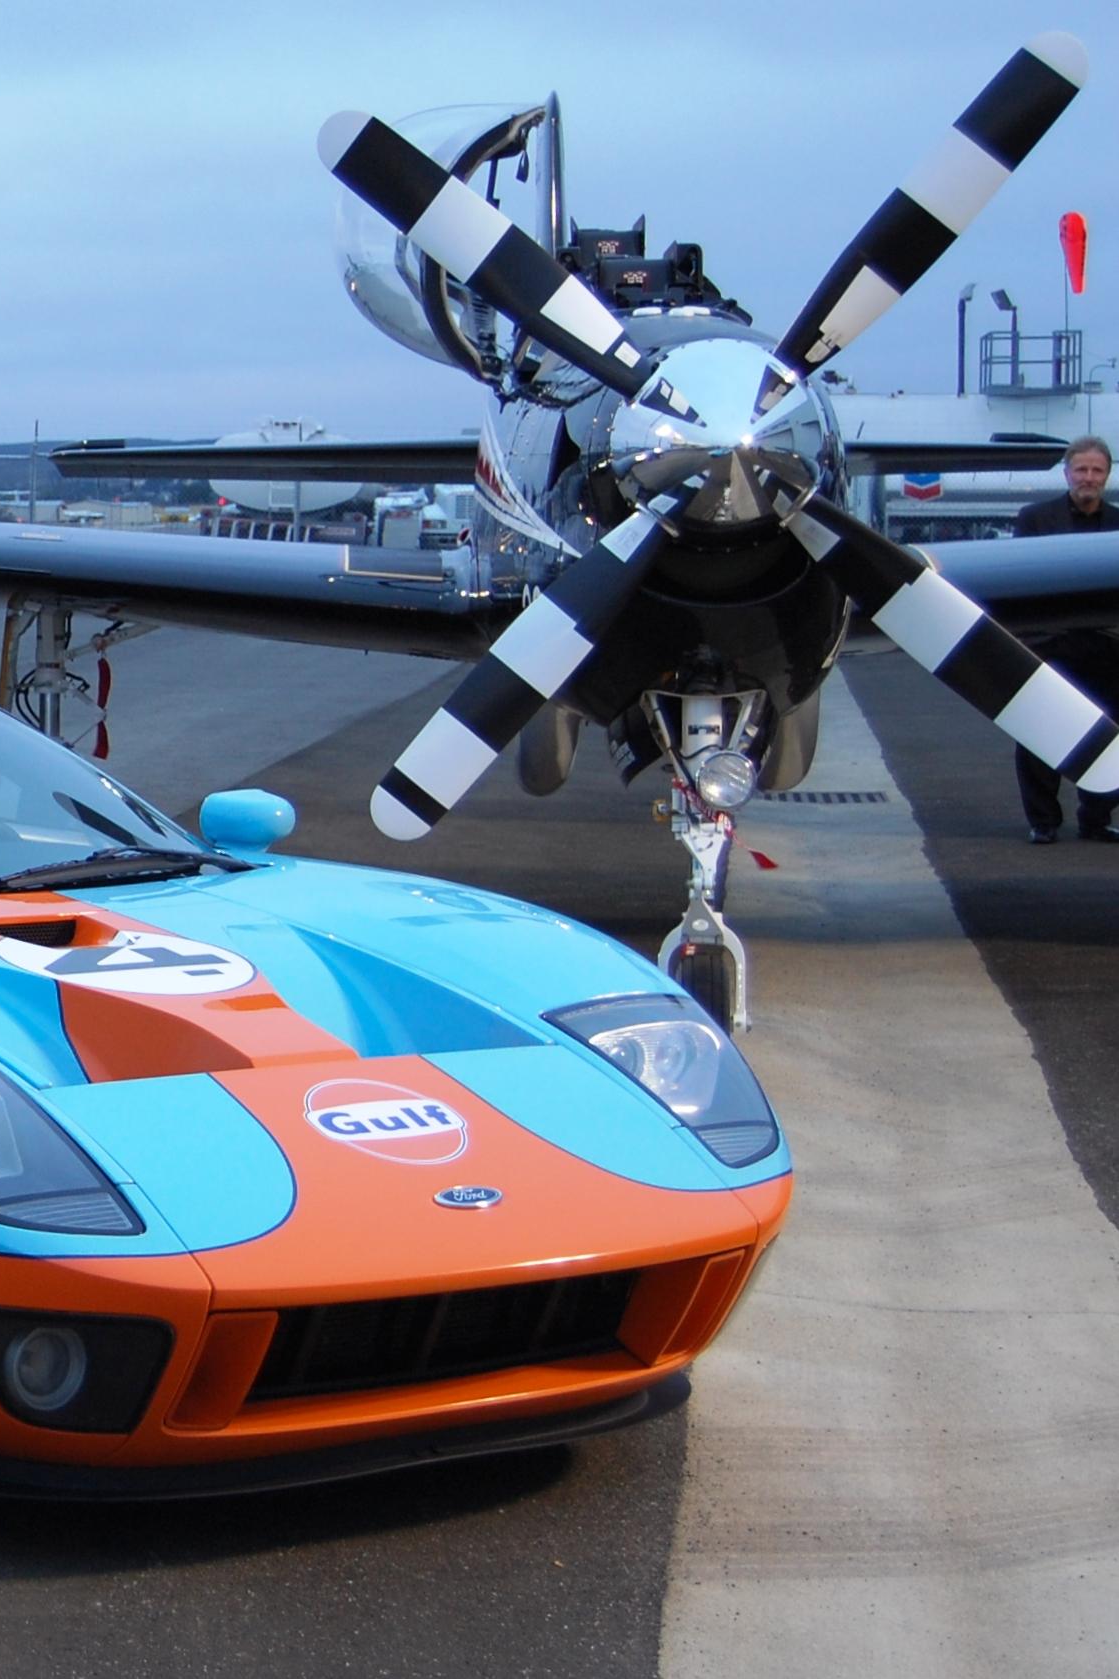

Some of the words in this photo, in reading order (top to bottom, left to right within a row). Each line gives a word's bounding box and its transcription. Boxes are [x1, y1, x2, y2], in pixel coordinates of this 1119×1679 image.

[43, 935, 232, 977] 4
[317, 1104, 452, 1136] Gulf
[452, 1188, 488, 1202] Ford
